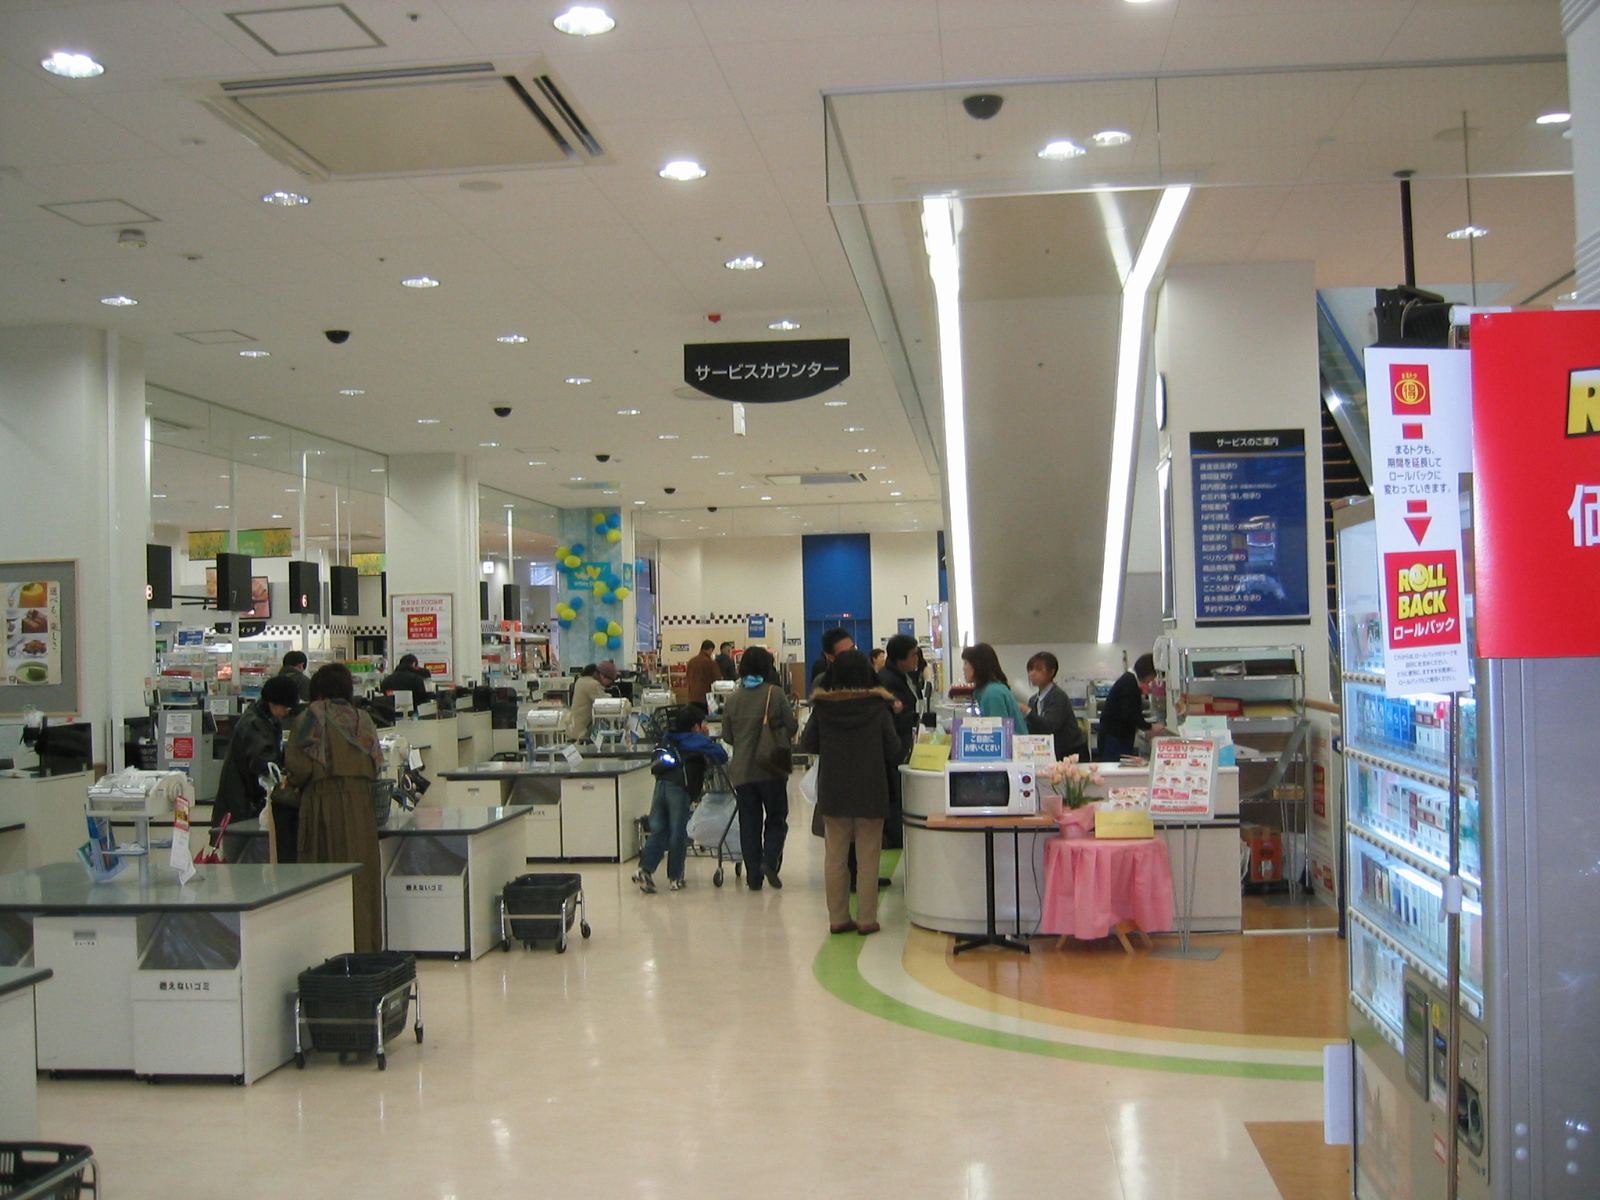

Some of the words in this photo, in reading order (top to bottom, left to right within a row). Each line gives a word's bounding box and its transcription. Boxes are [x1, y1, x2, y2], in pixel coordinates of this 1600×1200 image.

[695, 361, 840, 381] サービスカウンター
[1403, 383, 1416, 400] 得
[1216, 437, 1279, 448] サービスのご案内
[1395, 445, 1435, 455] まるトクも、
[1387, 457, 1442, 468] 期間を延長して
[1389, 470, 1442, 481] ロールバックに
[1384, 483, 1451, 495] 変わっていきます。
[145, 585, 153, 601] 8
[232, 590, 238, 603] 7
[301, 594, 308, 608] 6
[343, 598, 348, 609] 5
[1398, 589, 1447, 620] BACK
[1393, 617, 1455, 641] ロールバック
[970, 735, 995, 743] ご自由に
[964, 743, 1000, 752] お使いください
[159, 981, 210, 991] 燃えないゴミ
